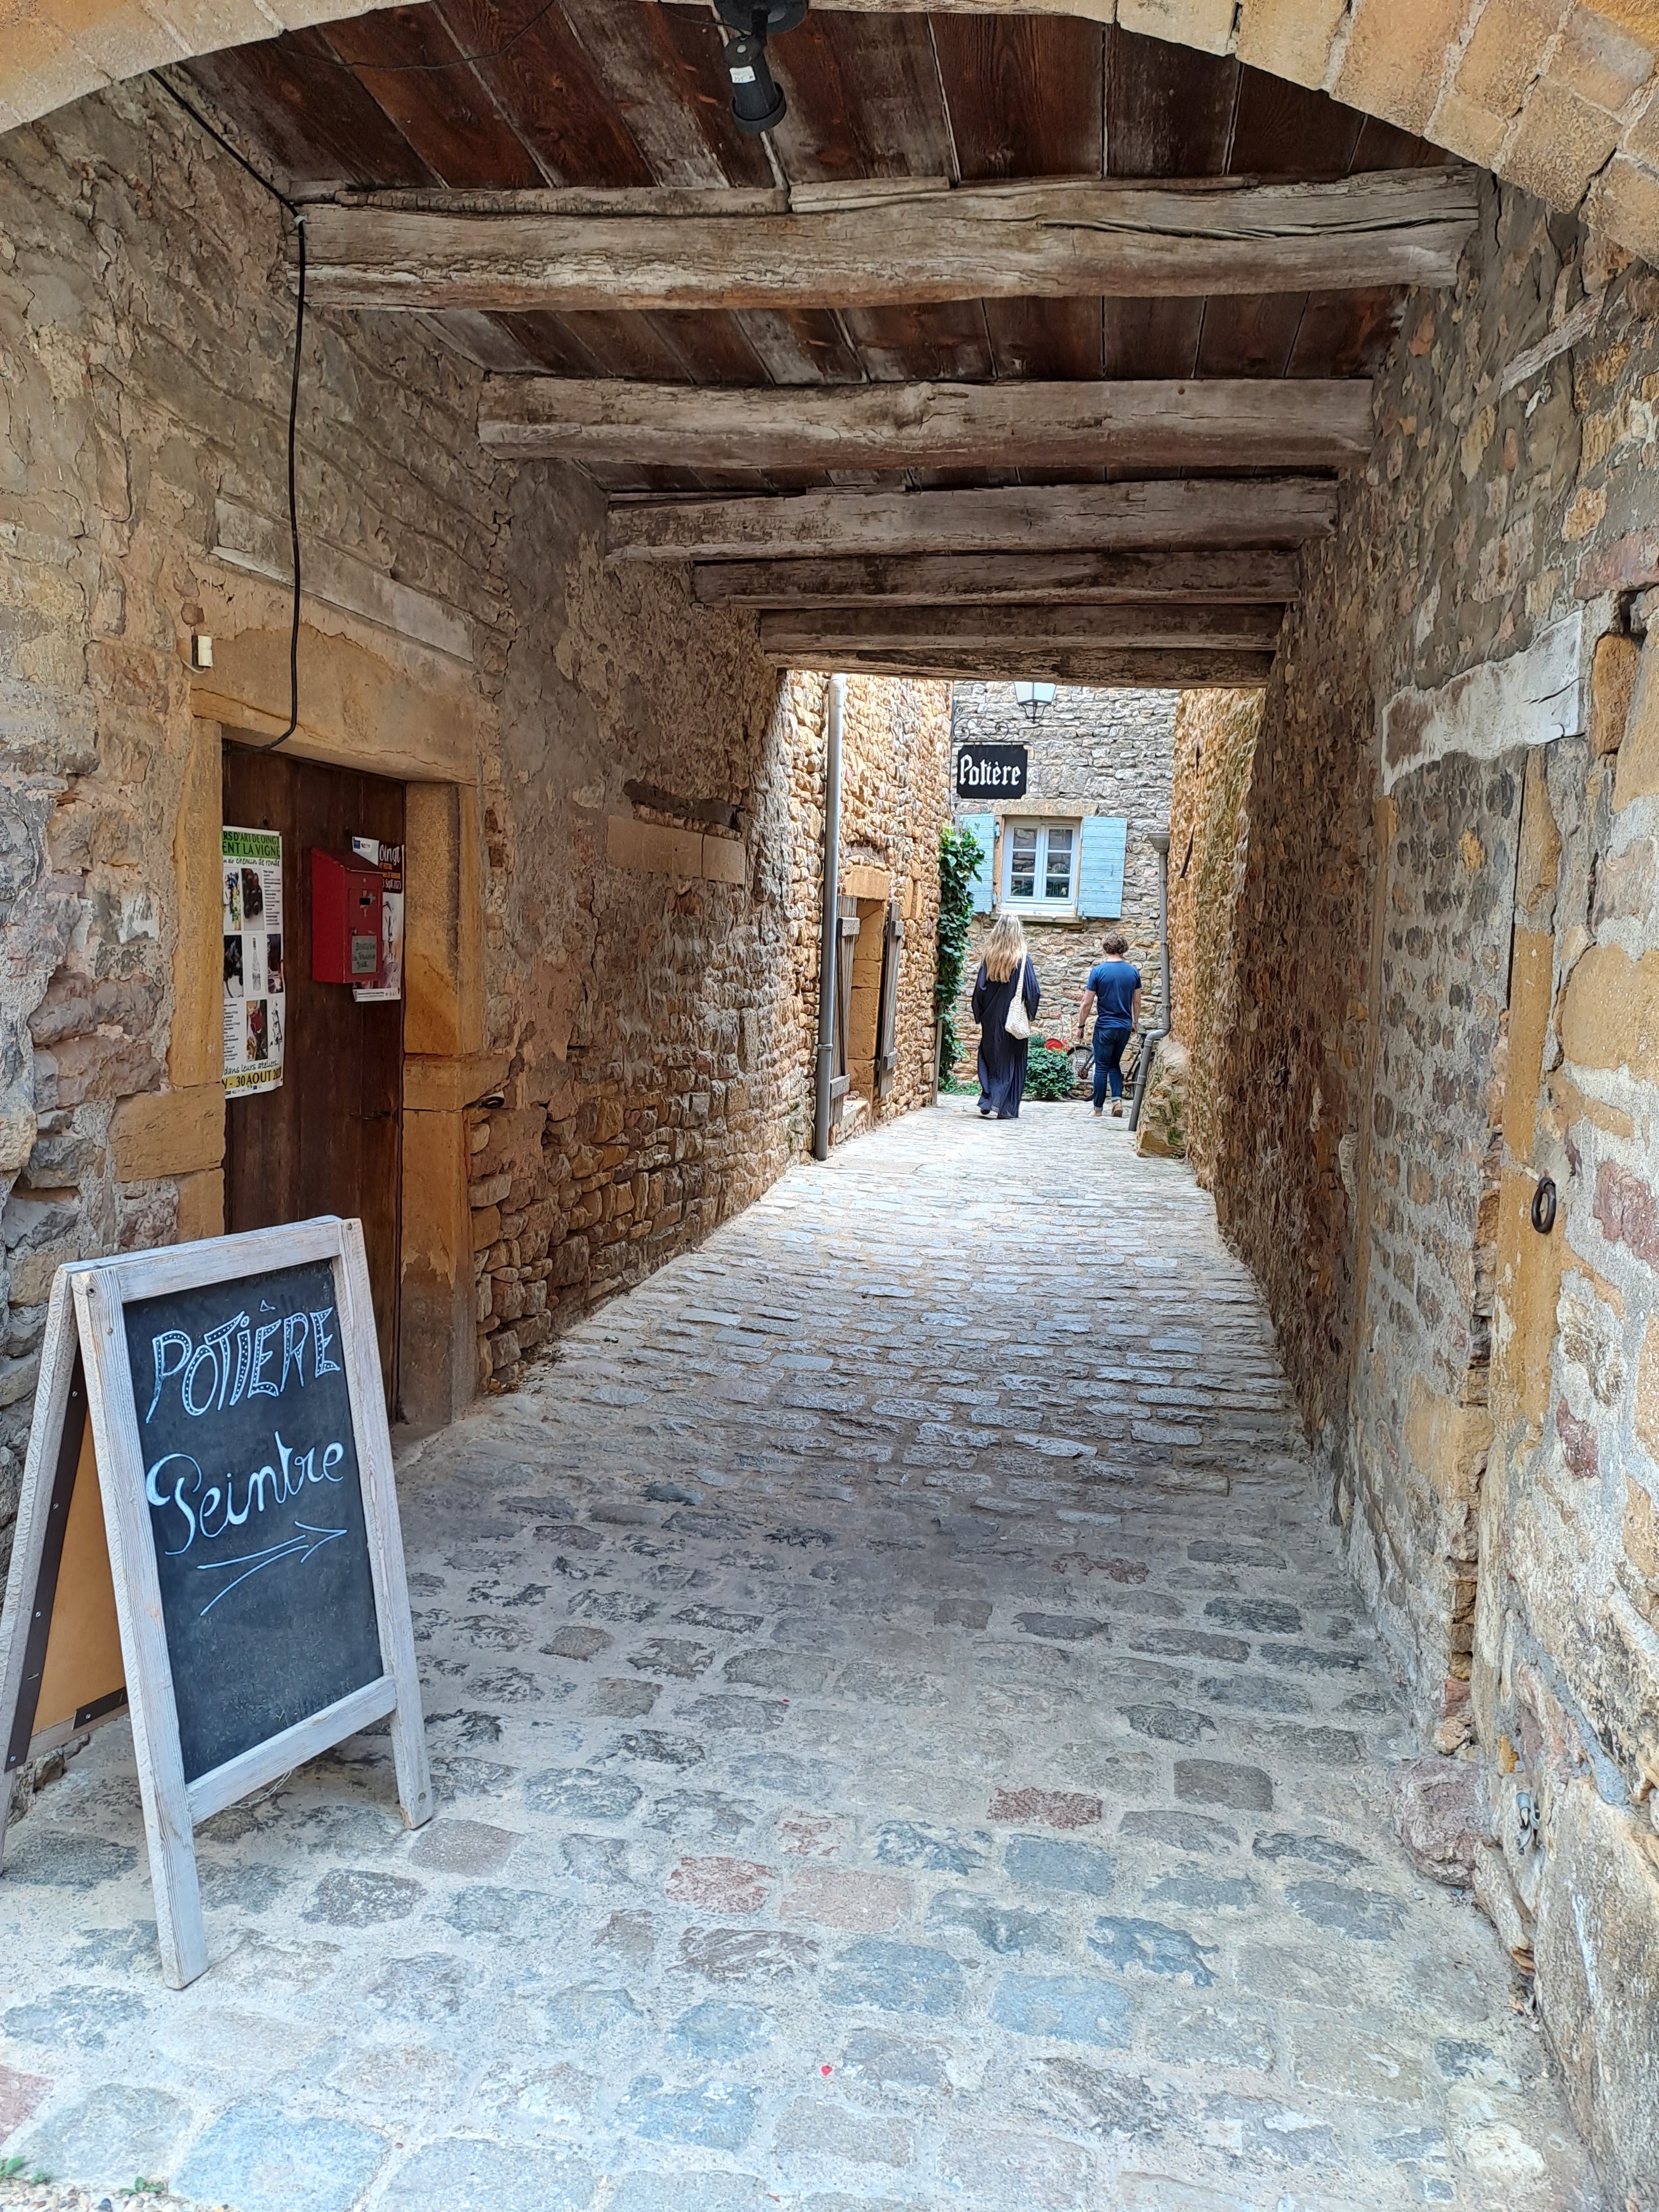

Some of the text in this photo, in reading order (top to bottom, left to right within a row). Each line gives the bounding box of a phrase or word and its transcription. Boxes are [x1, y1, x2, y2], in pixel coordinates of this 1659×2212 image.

[959, 754, 1021, 785] Potière
[222, 831, 232, 841] RS
[252, 834, 260, 843] DE
[261, 835, 280, 845] OINGT
[243, 843, 254, 855] LA
[255, 844, 280, 858] VIGNE
[379, 844, 401, 865] Oingt
[224, 1066, 239, 1075] dans
[241, 1064, 256, 1072] leurs
[236, 1076, 246, 1087] 30
[247, 1071, 272, 1085] AOUT
[145, 1300, 341, 1424] POTIÈRE
[145, 1431, 344, 1556] Peintre
